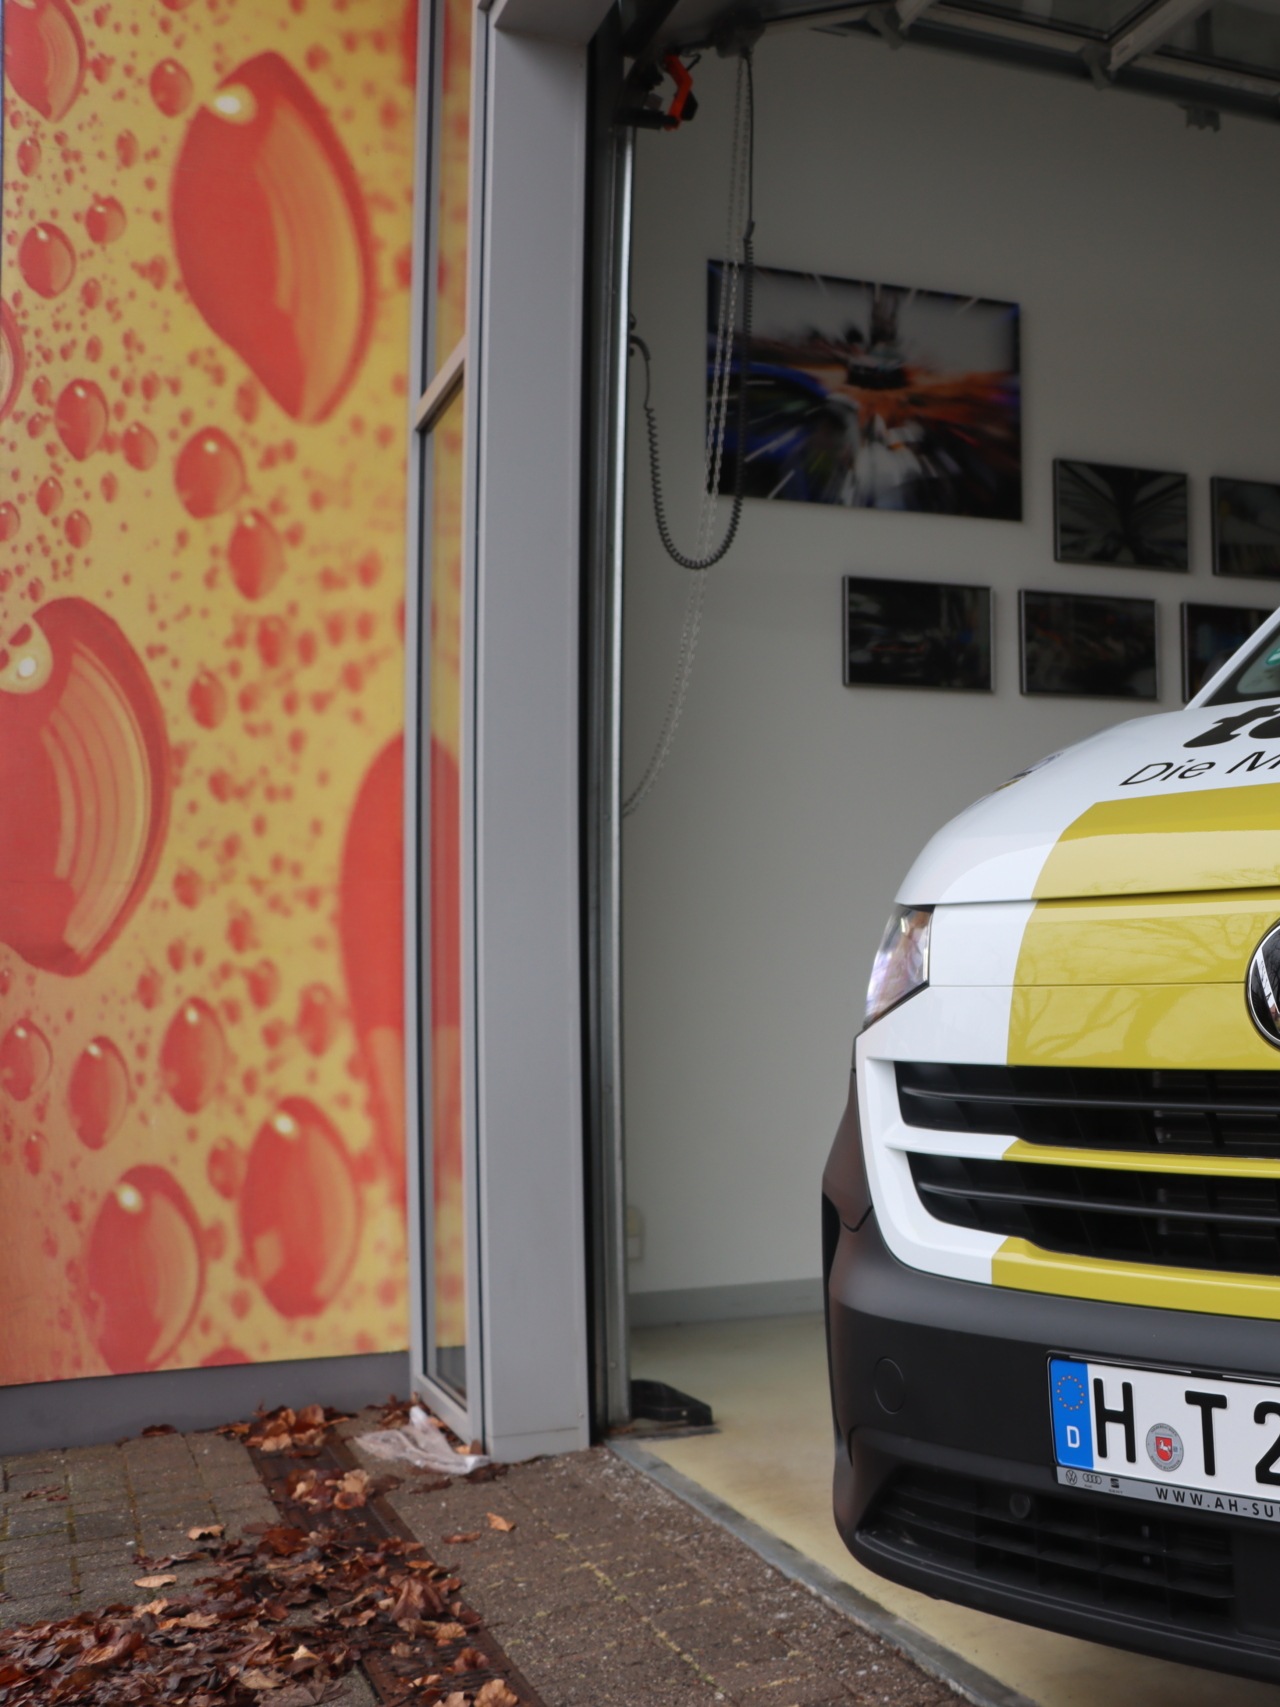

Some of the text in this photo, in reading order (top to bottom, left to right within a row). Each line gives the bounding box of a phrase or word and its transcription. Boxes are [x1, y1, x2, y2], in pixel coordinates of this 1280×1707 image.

[1118, 759, 1216, 786] Die
[1066, 1425, 1080, 1449] D
[1093, 1377, 1136, 1463] H
[1185, 1390, 1227, 1476] T
